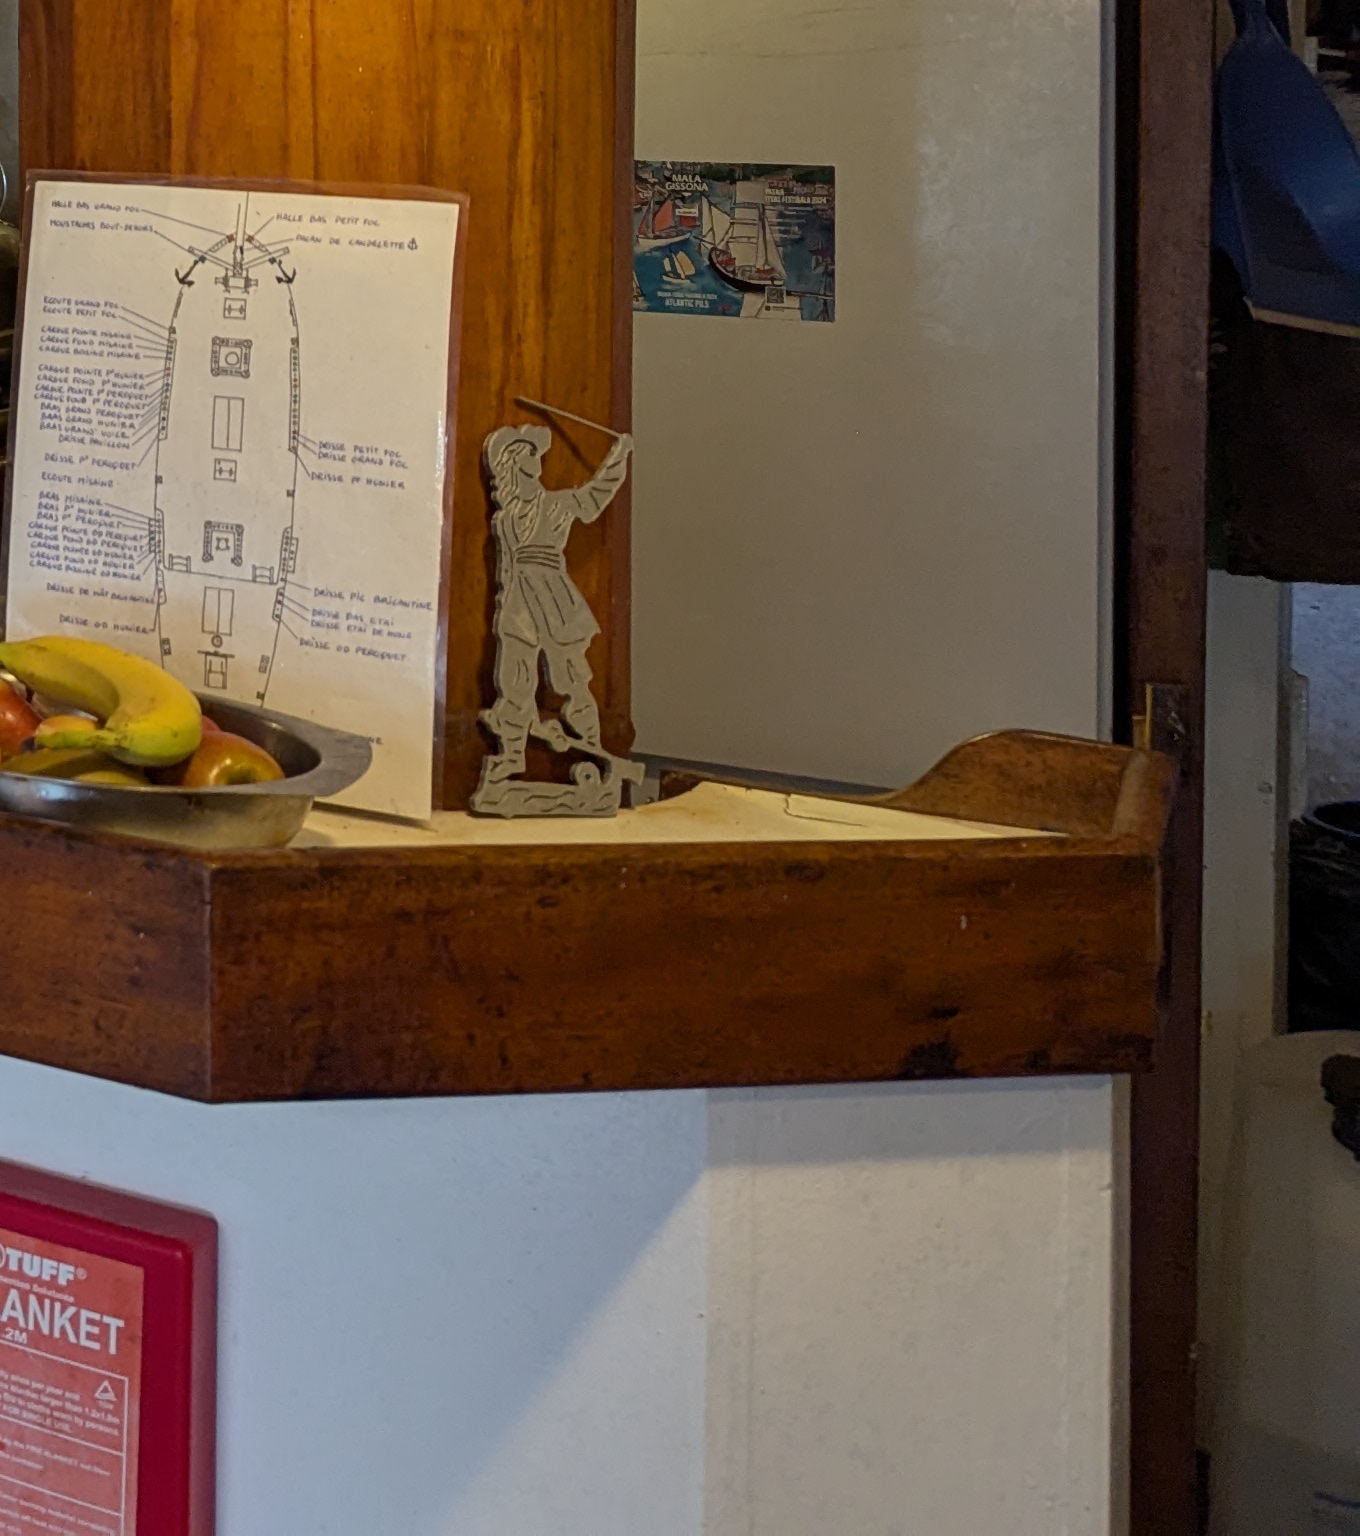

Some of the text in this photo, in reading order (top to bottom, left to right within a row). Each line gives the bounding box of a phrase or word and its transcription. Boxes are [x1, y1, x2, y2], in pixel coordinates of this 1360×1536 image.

[672, 174, 701, 183] MALA
[329, 237, 341, 245] DE
[4, 1247, 75, 1286] TUFF
